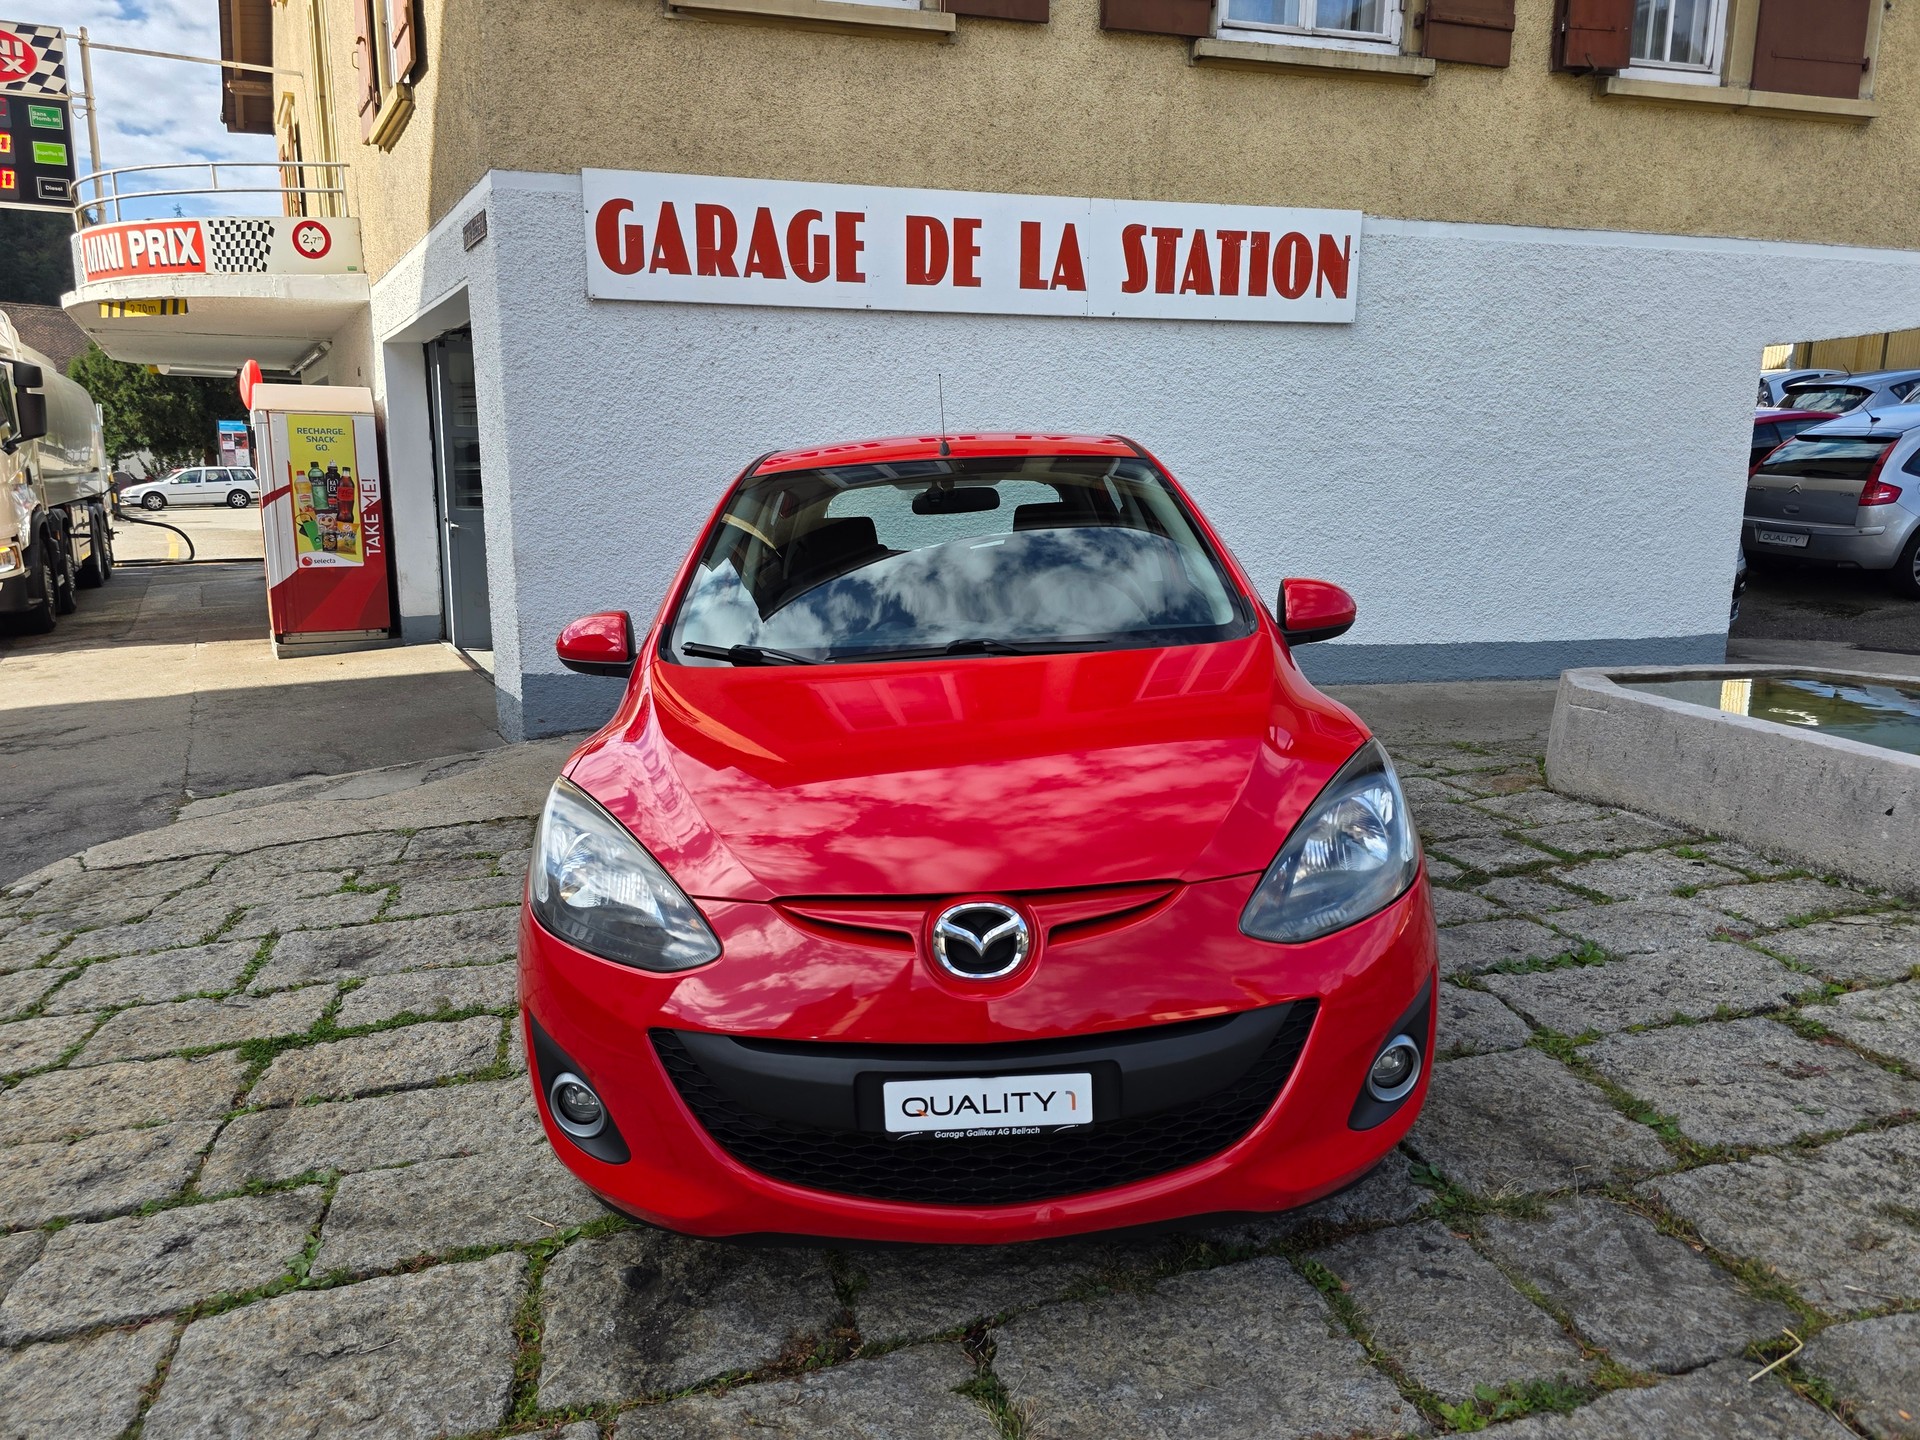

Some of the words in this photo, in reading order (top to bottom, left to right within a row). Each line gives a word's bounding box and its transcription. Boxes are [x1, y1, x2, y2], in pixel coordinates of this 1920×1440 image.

[44, 184, 63, 192] Diesel
[84, 232, 124, 274] MINI
[127, 227, 201, 267] PRIX
[595, 198, 866, 284] GARAGE
[906, 214, 982, 287] DE
[1019, 221, 1087, 292] LA
[1121, 223, 1351, 300] STATION
[297, 427, 346, 436] RECHARGE.
[305, 435, 338, 444] SNACK.
[315, 444, 330, 452] GO.
[361, 478, 376, 511] ME!
[365, 513, 381, 557] TAKE
[1762, 534, 1800, 544] QUALITY
[901, 1091, 1057, 1117] QUALITY
[1065, 1090, 1077, 1111] 1
[934, 1130, 964, 1139] Garage
